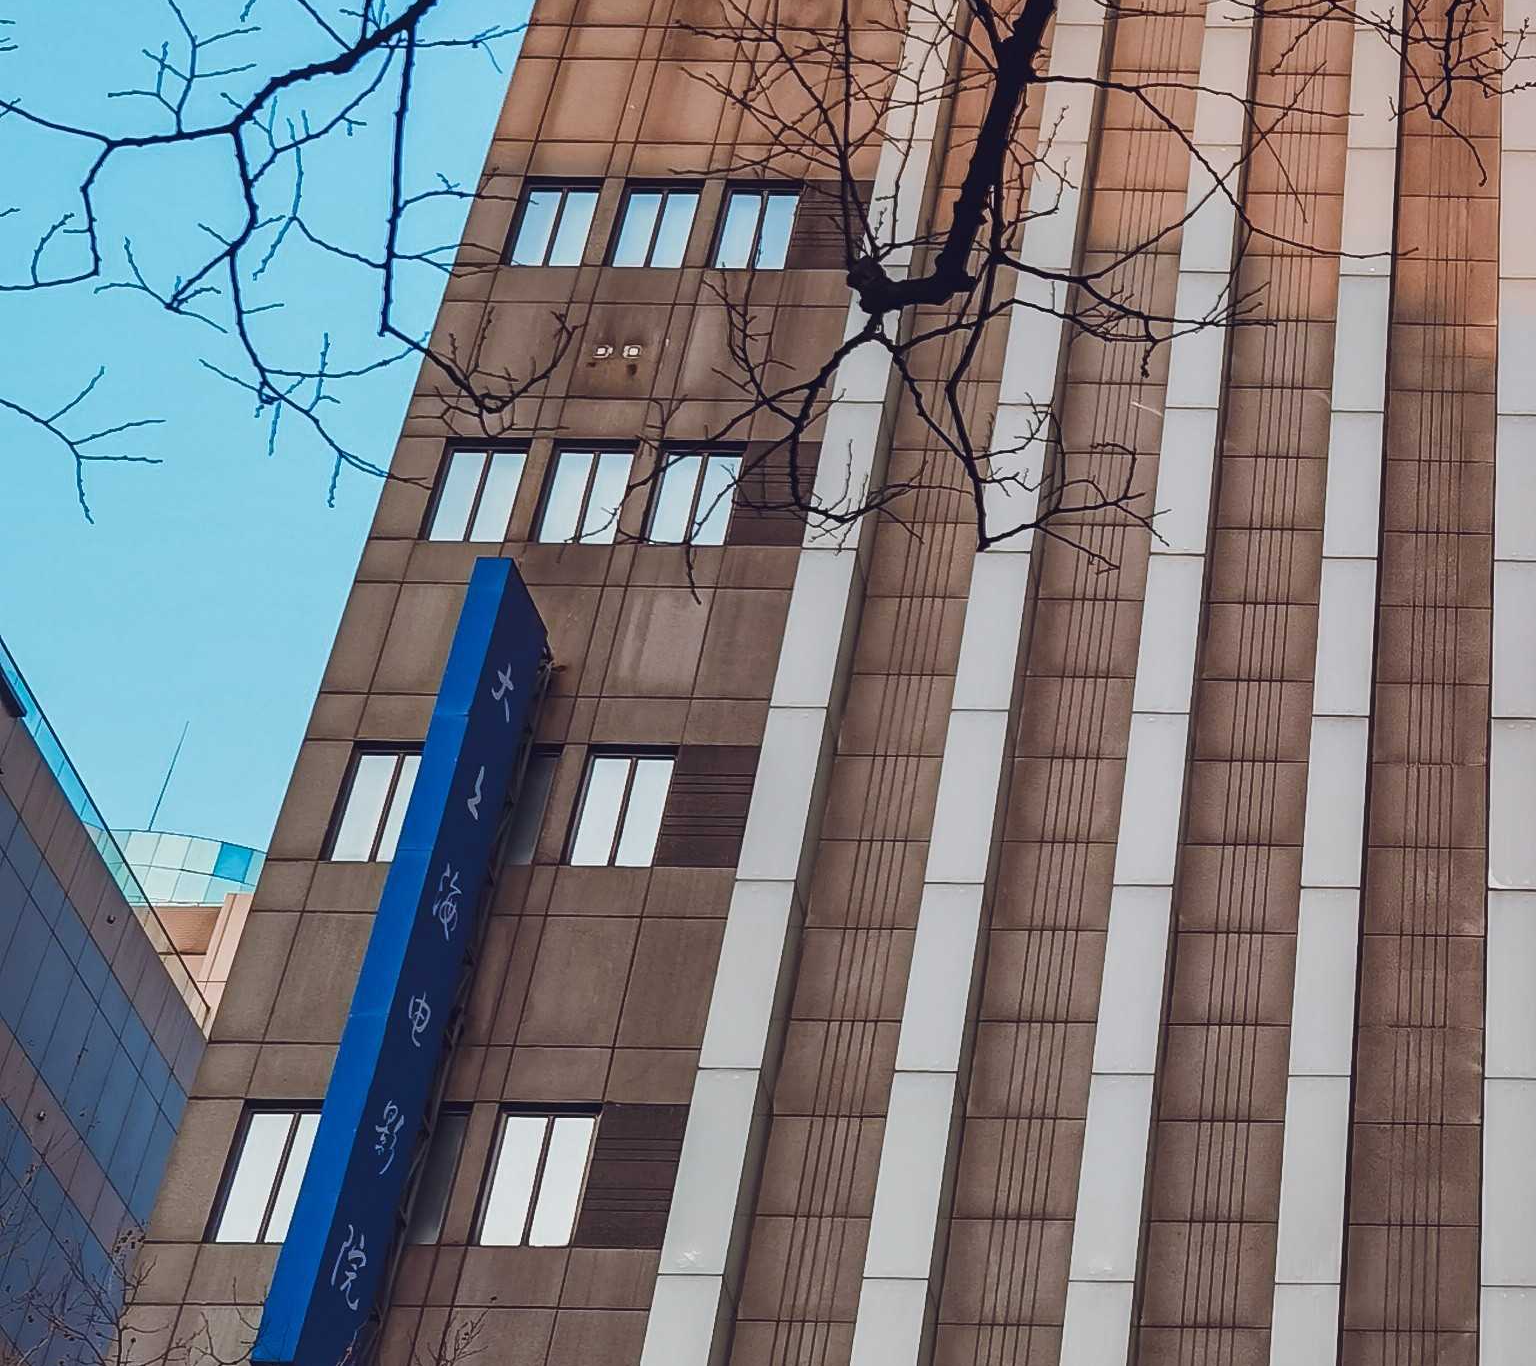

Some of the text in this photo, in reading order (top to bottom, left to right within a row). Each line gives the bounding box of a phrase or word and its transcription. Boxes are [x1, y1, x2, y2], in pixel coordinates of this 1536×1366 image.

[327, 663, 516, 1313] 大上海电影院
